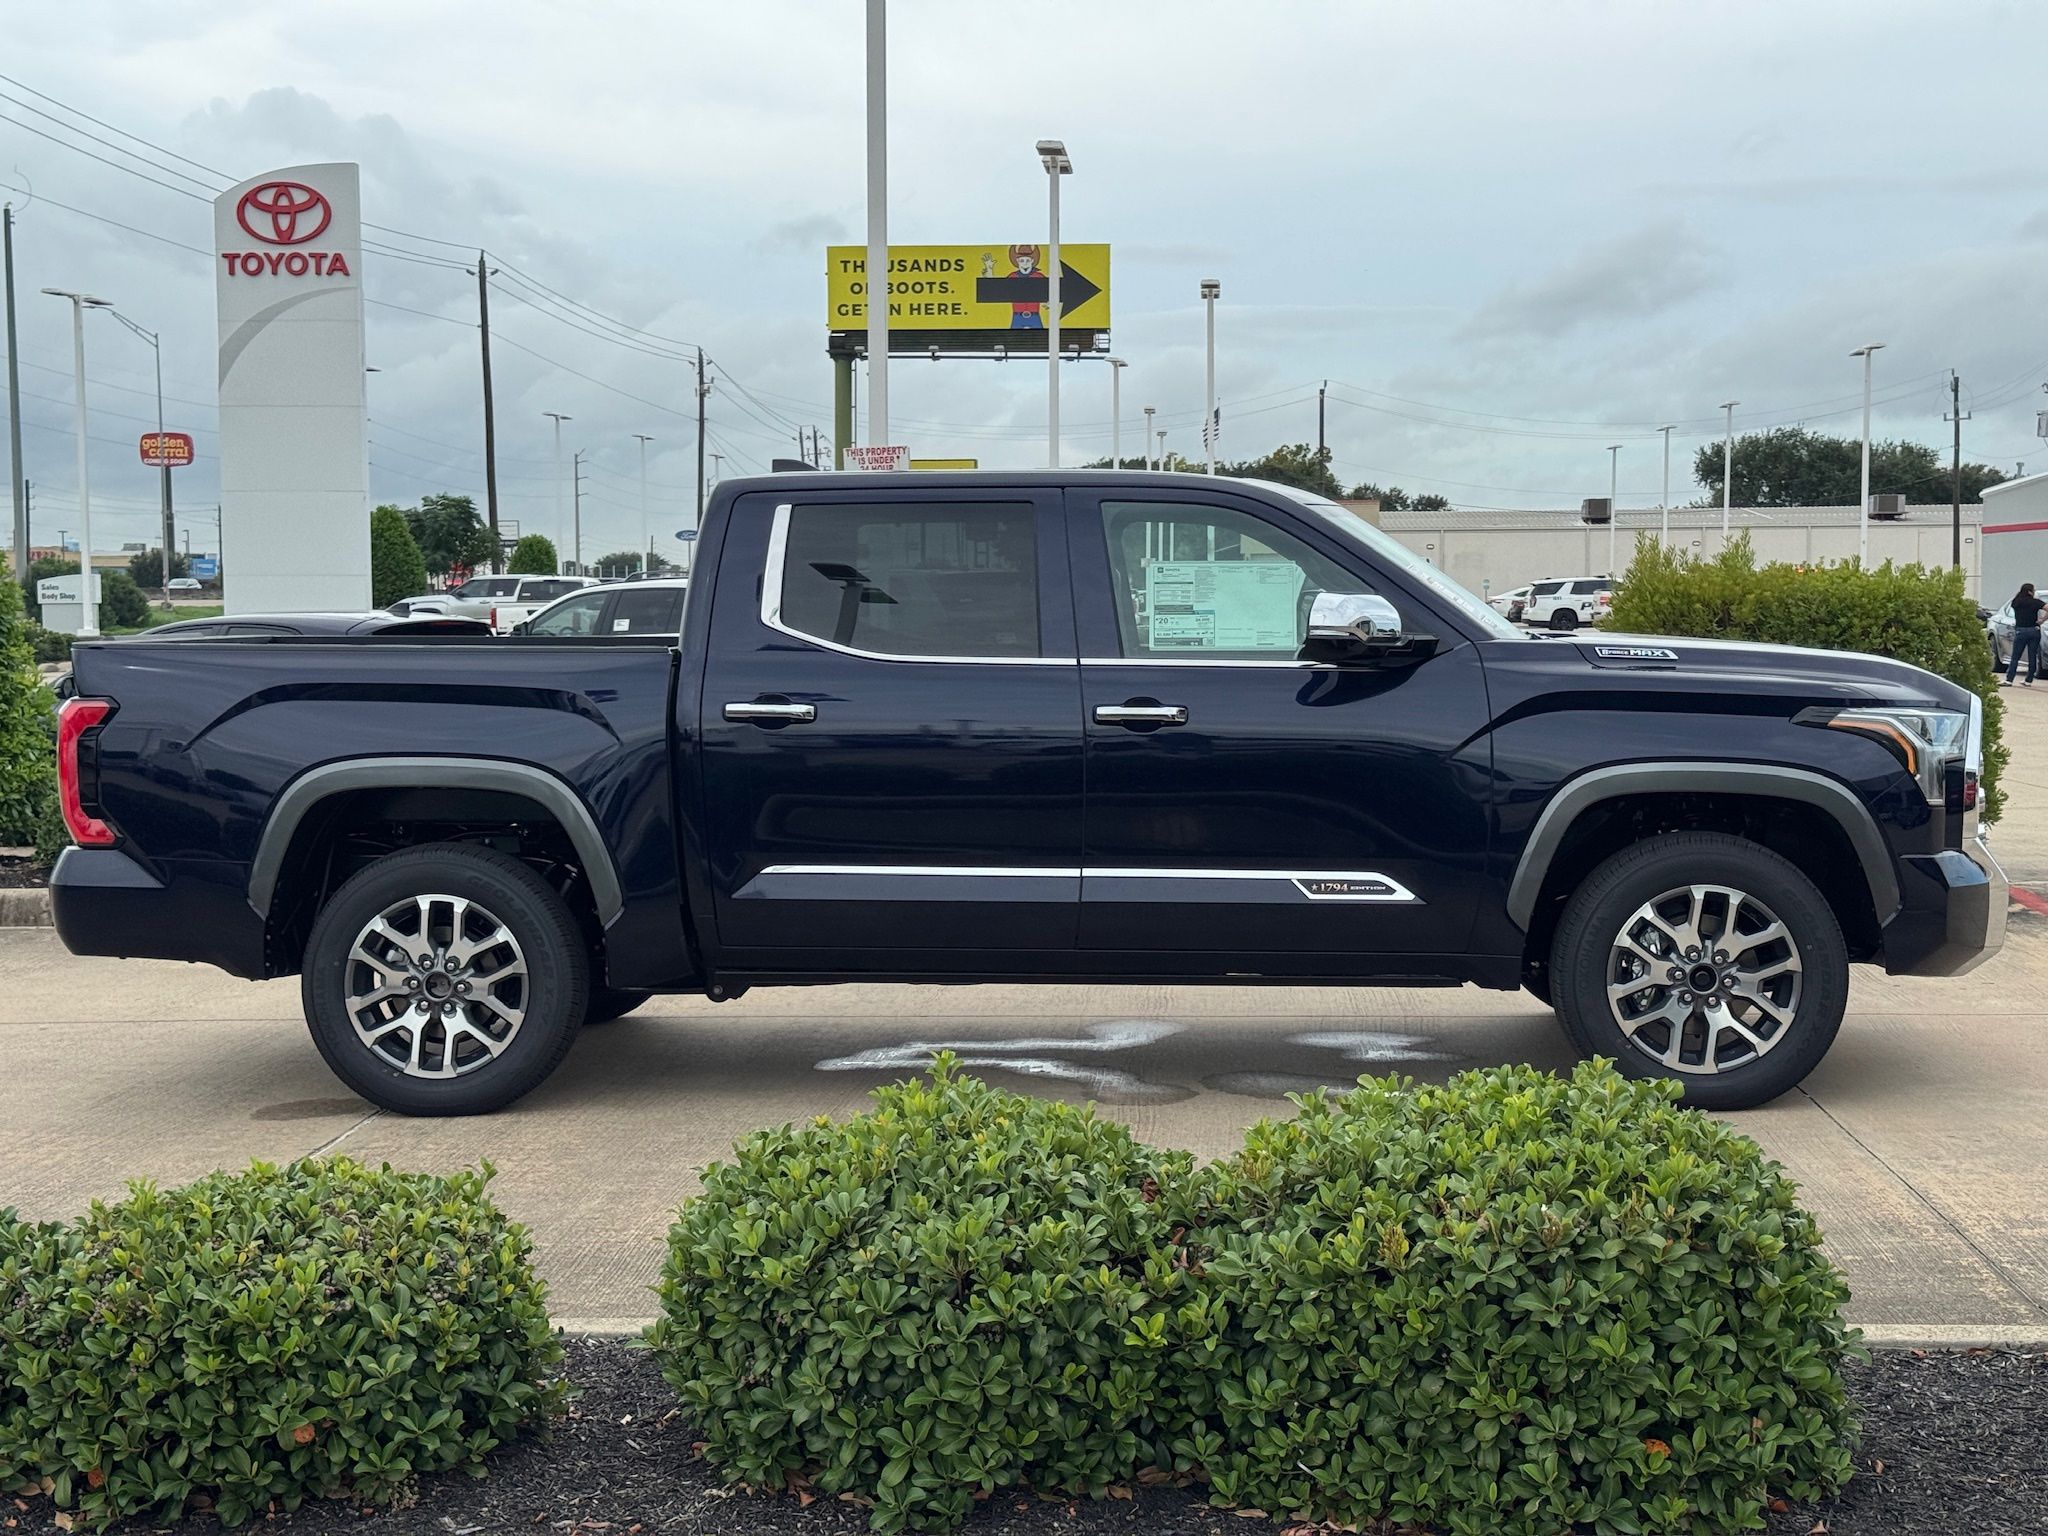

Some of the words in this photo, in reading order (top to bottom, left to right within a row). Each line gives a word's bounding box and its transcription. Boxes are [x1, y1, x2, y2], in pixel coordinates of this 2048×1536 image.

[222, 253, 350, 276] TOYOTA
[840, 259, 965, 273] THUSANDS
[850, 282, 869, 295] O
[837, 304, 869, 316] GE
[909, 303, 968, 316] HERE.
[845, 448, 864, 457] THIS
[866, 446, 907, 456] PROPERTY
[858, 457, 866, 465] IS
[868, 456, 895, 465] UNDER
[41, 593, 58, 601] Body
[59, 593, 76, 601] Shop
[1320, 883, 1348, 892] 1794
